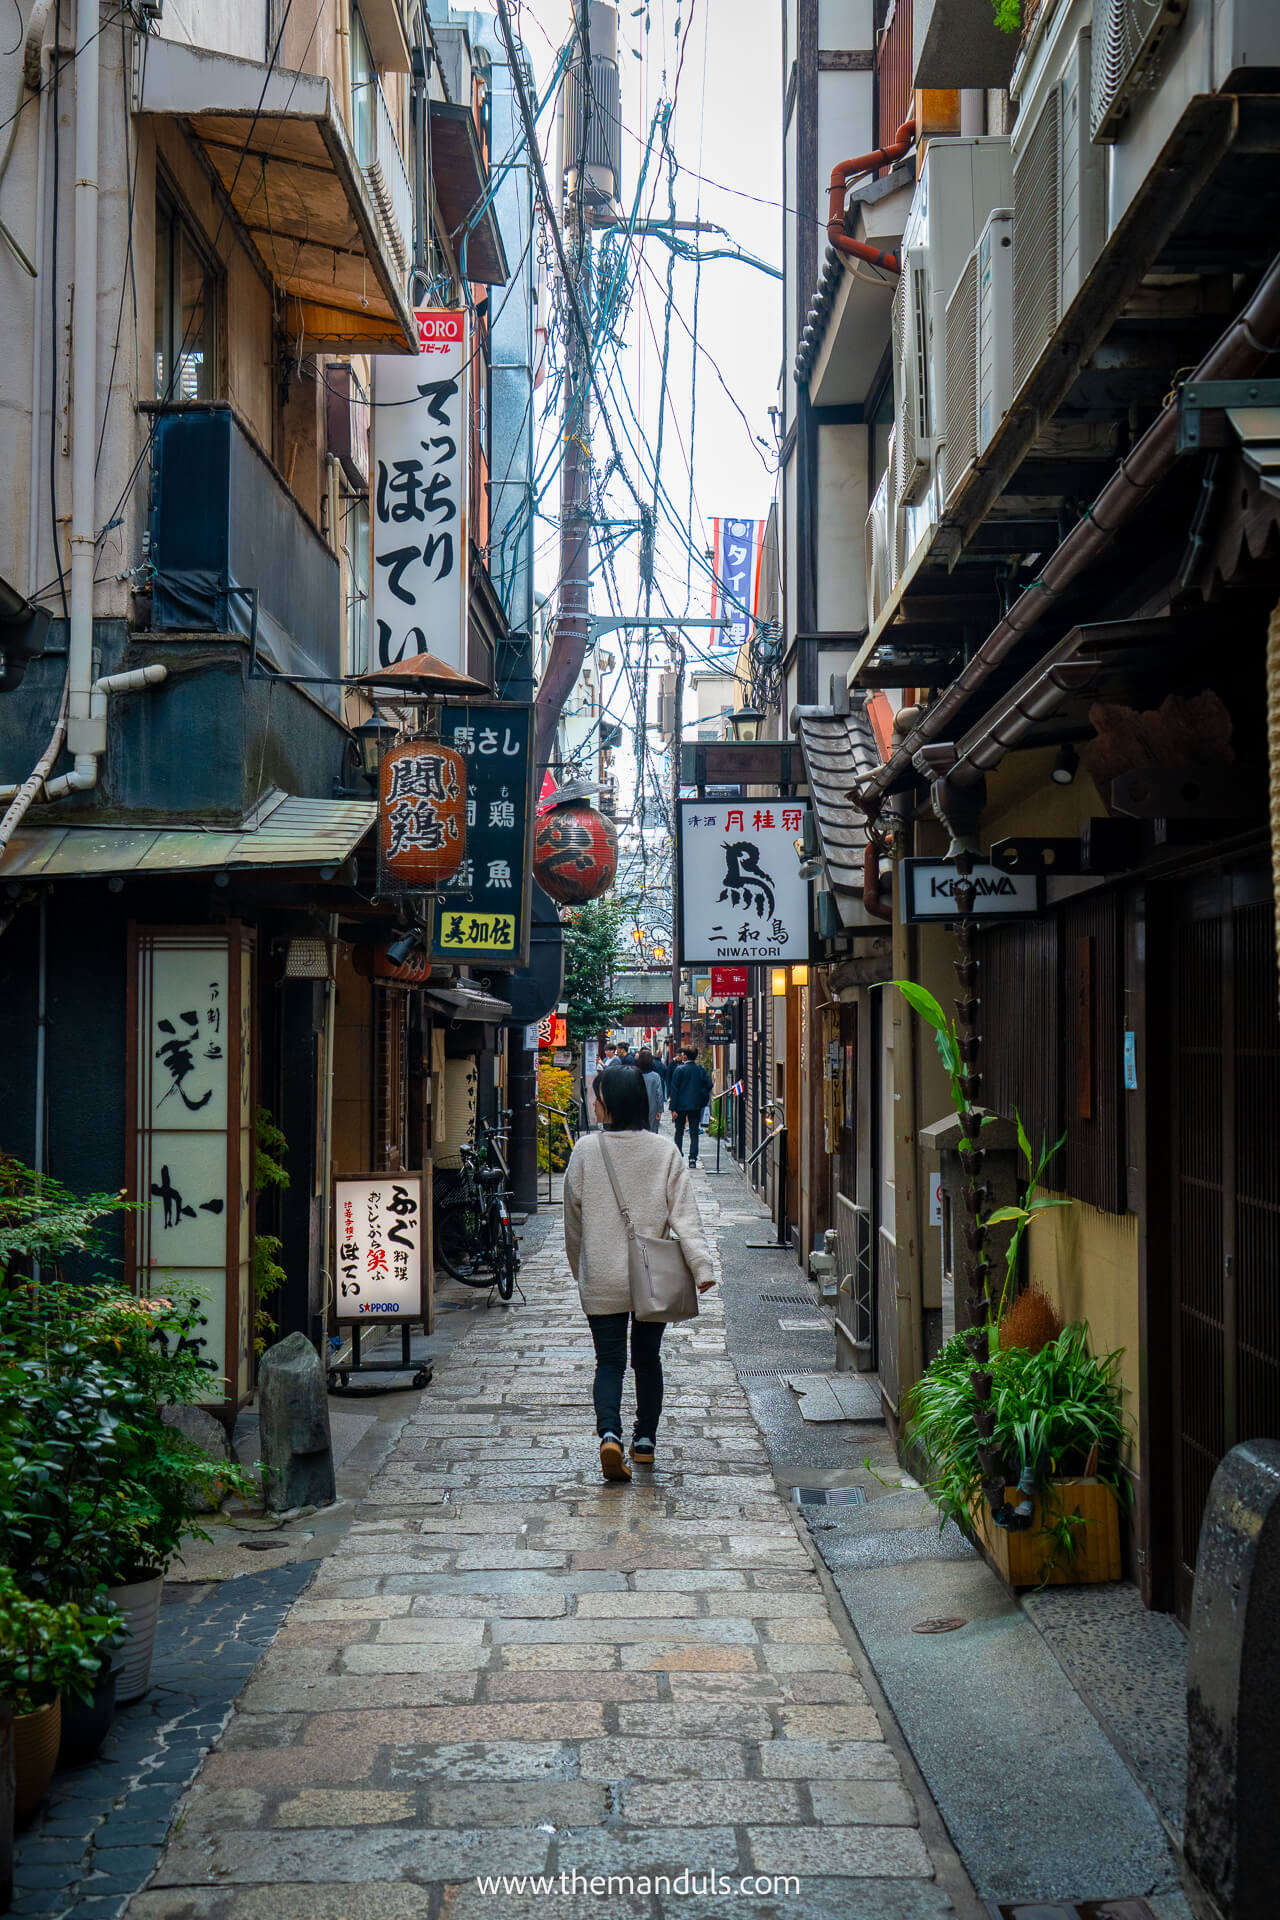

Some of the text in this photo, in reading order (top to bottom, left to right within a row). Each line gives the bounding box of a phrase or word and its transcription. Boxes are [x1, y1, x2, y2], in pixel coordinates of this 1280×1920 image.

[417, 379, 459, 583] てっちり
[375, 459, 429, 669] ほてい
[453, 726, 520, 756] 馬さし
[687, 809, 802, 832] 清酒 月桂冠
[444, 915, 513, 945] 美加佐
[708, 918, 789, 945] 二和鳥
[716, 947, 781, 957] NIWATORI
